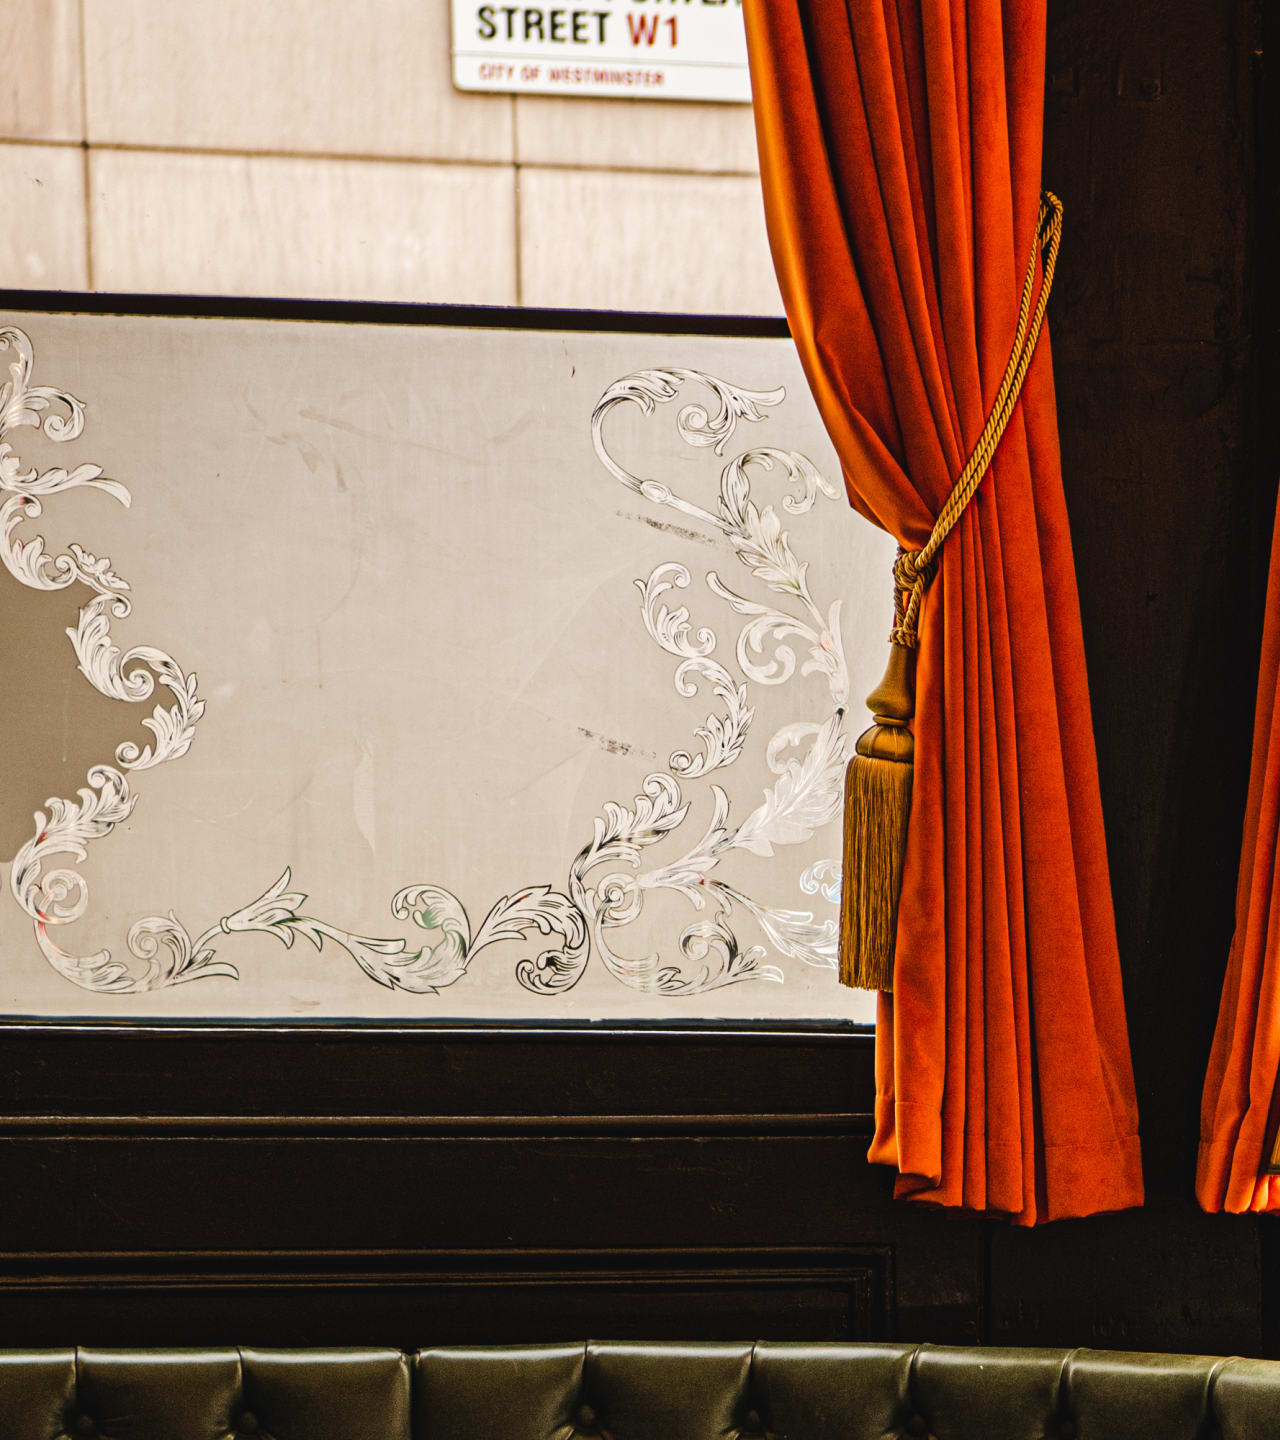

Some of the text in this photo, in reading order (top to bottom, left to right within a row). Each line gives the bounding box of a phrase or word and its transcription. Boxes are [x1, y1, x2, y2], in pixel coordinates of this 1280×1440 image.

[477, 6, 678, 47] STREET W1
[479, 63, 665, 86] CITY OF WESTMINSTER
